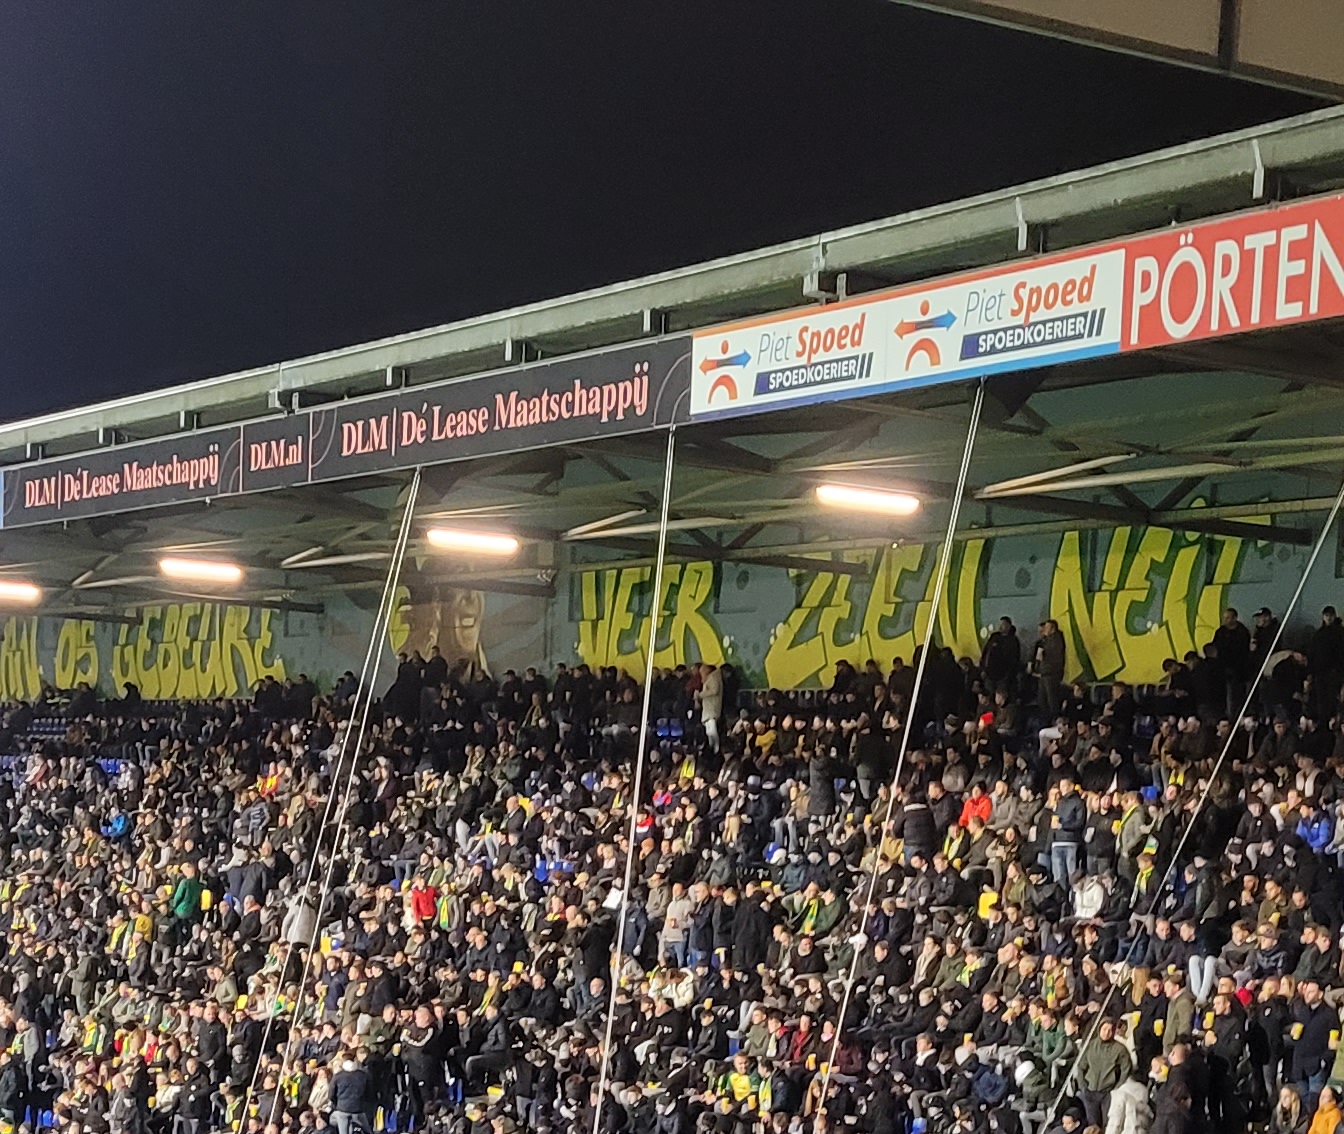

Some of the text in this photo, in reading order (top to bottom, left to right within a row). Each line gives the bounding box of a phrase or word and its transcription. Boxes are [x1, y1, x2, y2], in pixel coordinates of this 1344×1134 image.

[964, 263, 1097, 327] Piet Spoed
[757, 312, 866, 365] Piet Spoed
[977, 316, 1086, 353] SPOEDKOERIER
[768, 359, 856, 392] SPOEDKOERIER
[341, 415, 388, 457] DLM
[431, 404, 488, 441] Lease
[249, 435, 303, 472] DLM.nl
[24, 476, 57, 508] DLM
[80, 470, 120, 498] Lease
